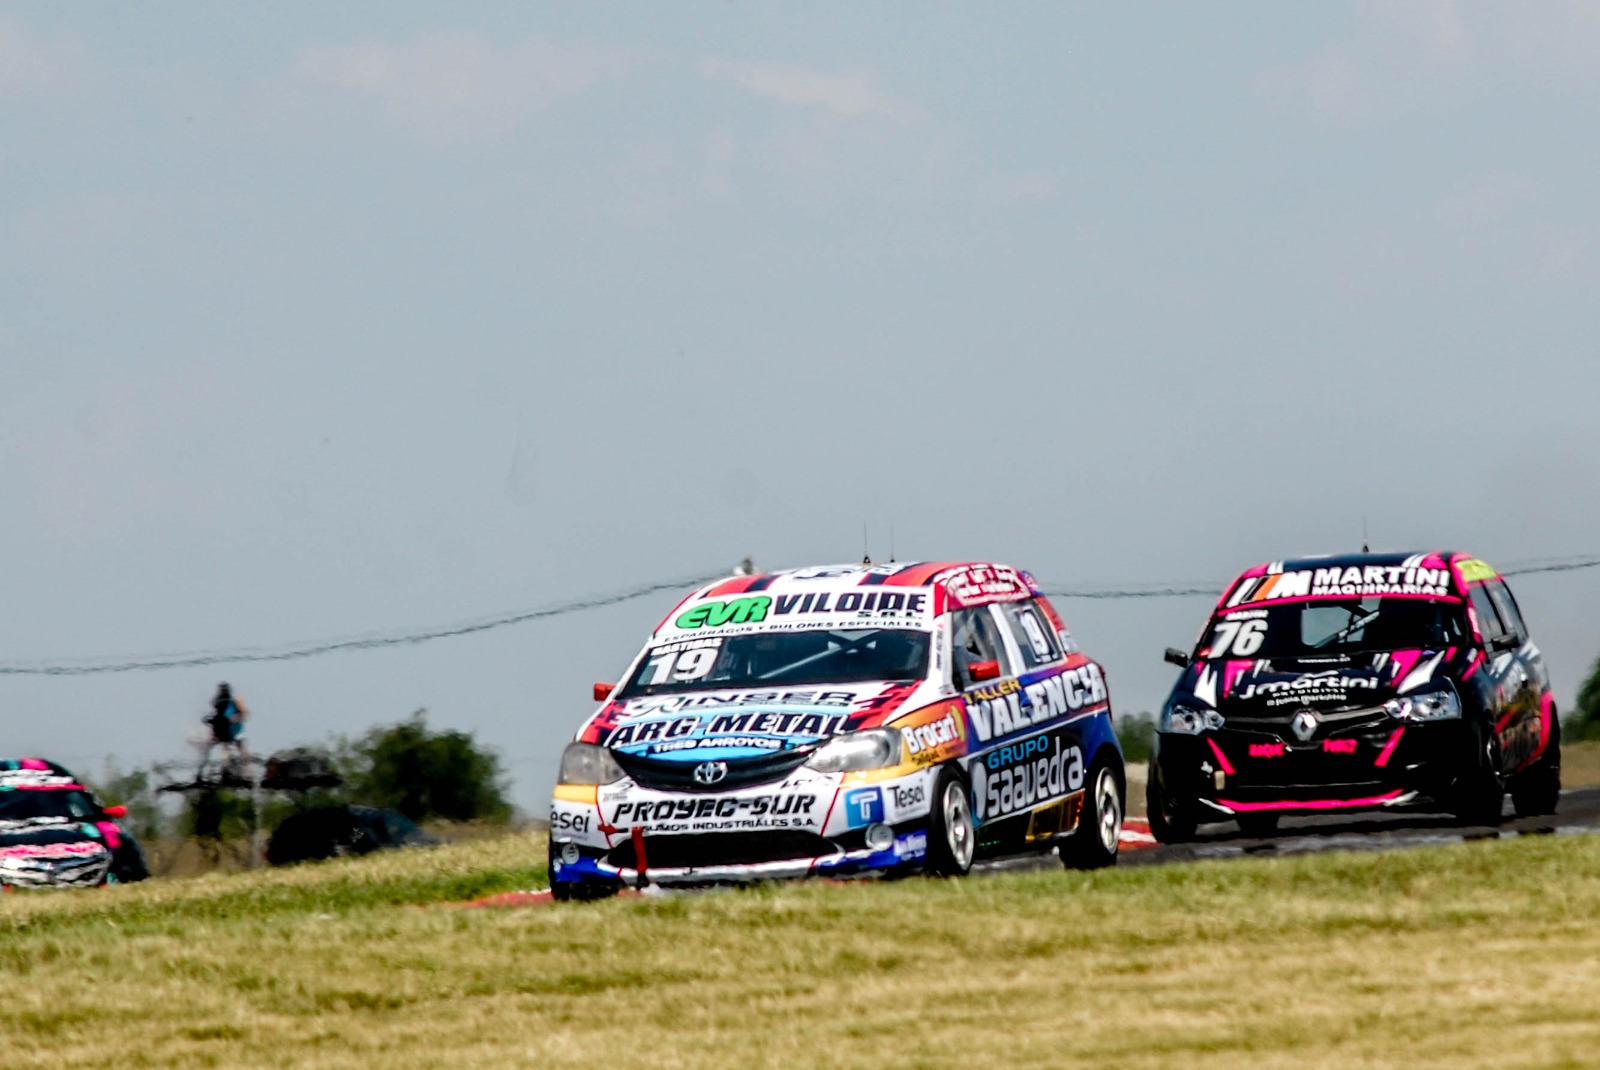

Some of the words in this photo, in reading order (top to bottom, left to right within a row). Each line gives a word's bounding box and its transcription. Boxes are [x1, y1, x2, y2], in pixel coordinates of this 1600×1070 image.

[1311, 582, 1449, 596] MAQUINARIAS
[1313, 565, 1450, 587] MARTINI
[675, 595, 773, 630] EVR
[773, 592, 926, 616] VILOIDE
[769, 621, 834, 631] BULONES
[1207, 619, 1269, 660] 76
[648, 647, 719, 686] 19
[962, 677, 1021, 704] TALLER
[604, 716, 702, 749] ARG
[705, 711, 851, 739] METAL
[902, 712, 959, 754] Brocart
[654, 740, 698, 754] TRES
[987, 735, 1049, 769] GRUPO
[987, 736, 1084, 818] saavedra
[887, 779, 925, 808] Tesei
[551, 805, 591, 833] esei
[612, 794, 817, 824] PROYEC-SUR
[692, 818, 788, 831] INDUSTRIALES
